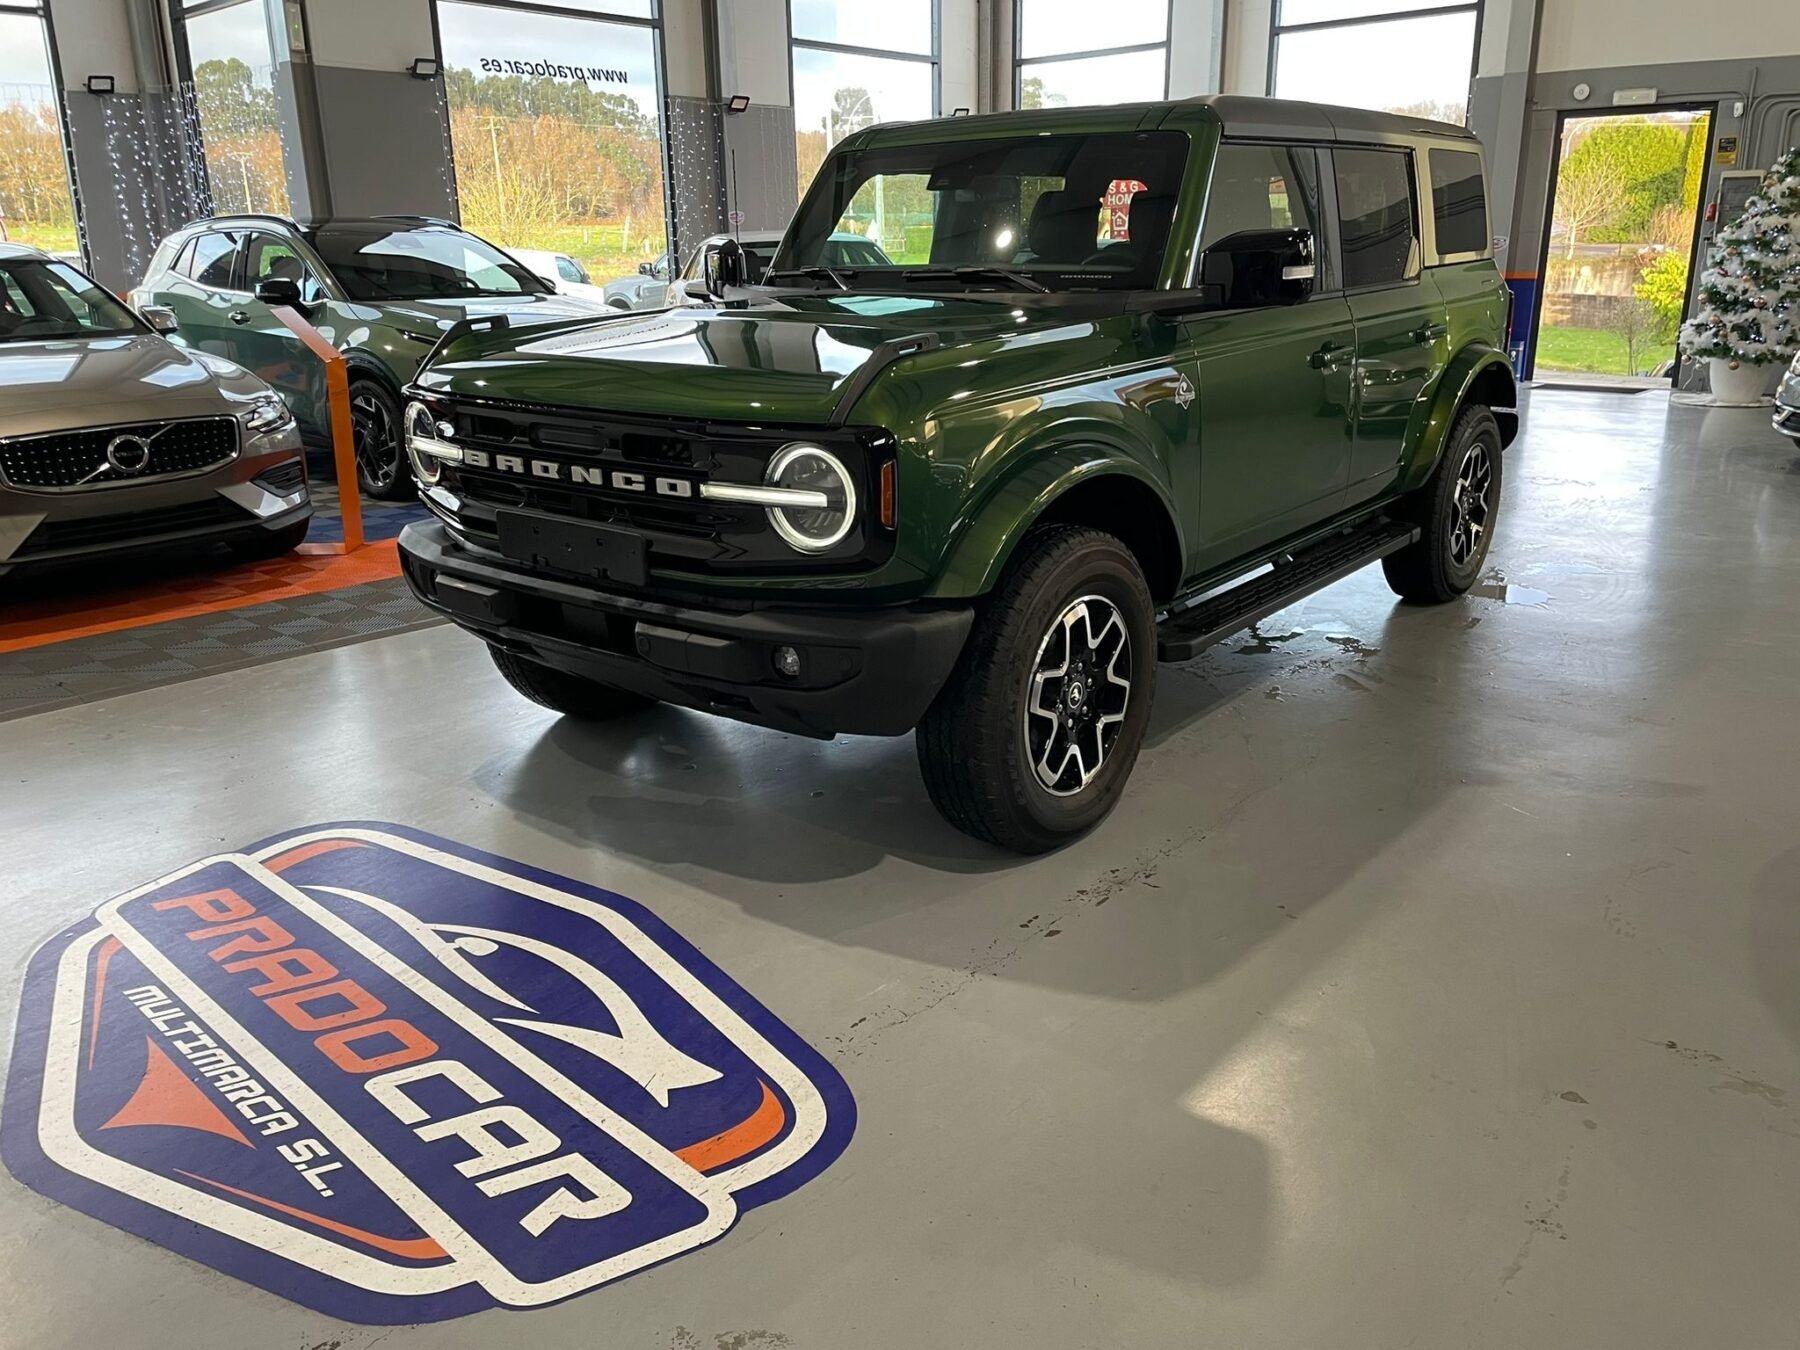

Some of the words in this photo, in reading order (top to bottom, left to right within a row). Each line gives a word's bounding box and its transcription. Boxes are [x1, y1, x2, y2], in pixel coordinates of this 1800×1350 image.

[463, 449, 692, 498] BRONCO
[122, 984, 300, 1136] MULTIMARCA
[275, 1137, 344, 1198] S.L.
